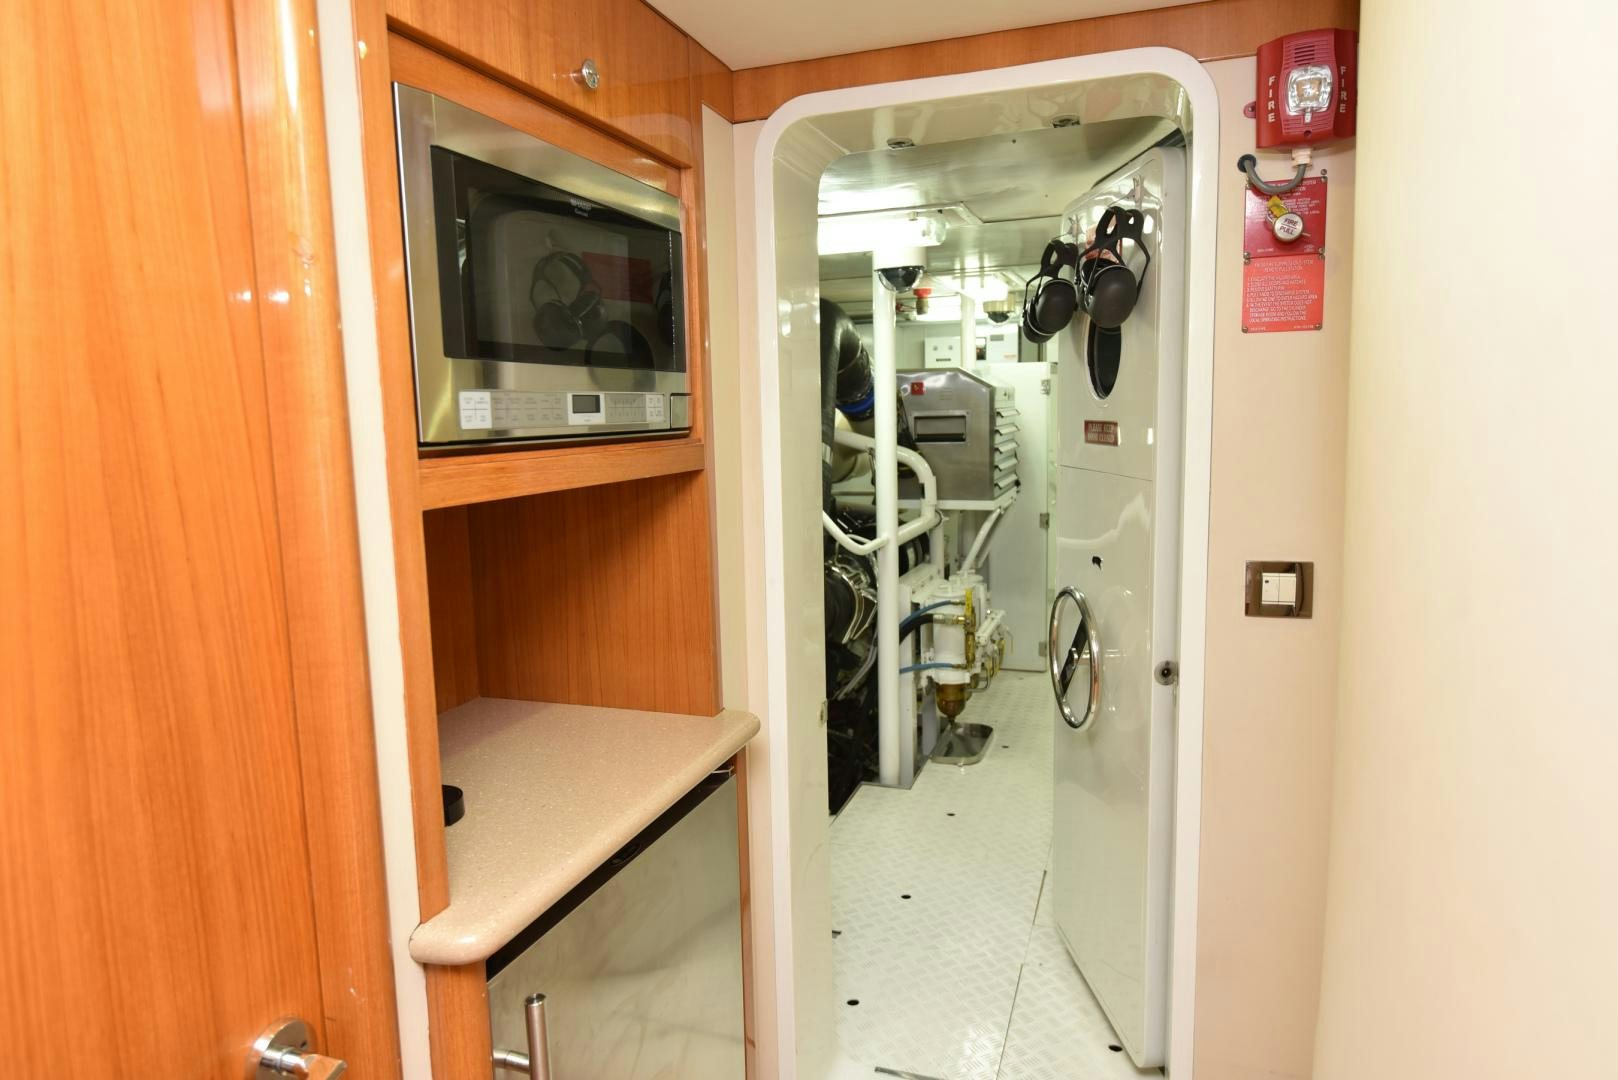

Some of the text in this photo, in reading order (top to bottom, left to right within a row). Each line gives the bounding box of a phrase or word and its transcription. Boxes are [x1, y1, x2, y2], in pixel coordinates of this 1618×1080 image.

[1268, 76, 1276, 123] FIRE
[1340, 66, 1348, 113] FIRE
[1279, 226, 1295, 236] PULL
[1284, 217, 1299, 227] FIRE
